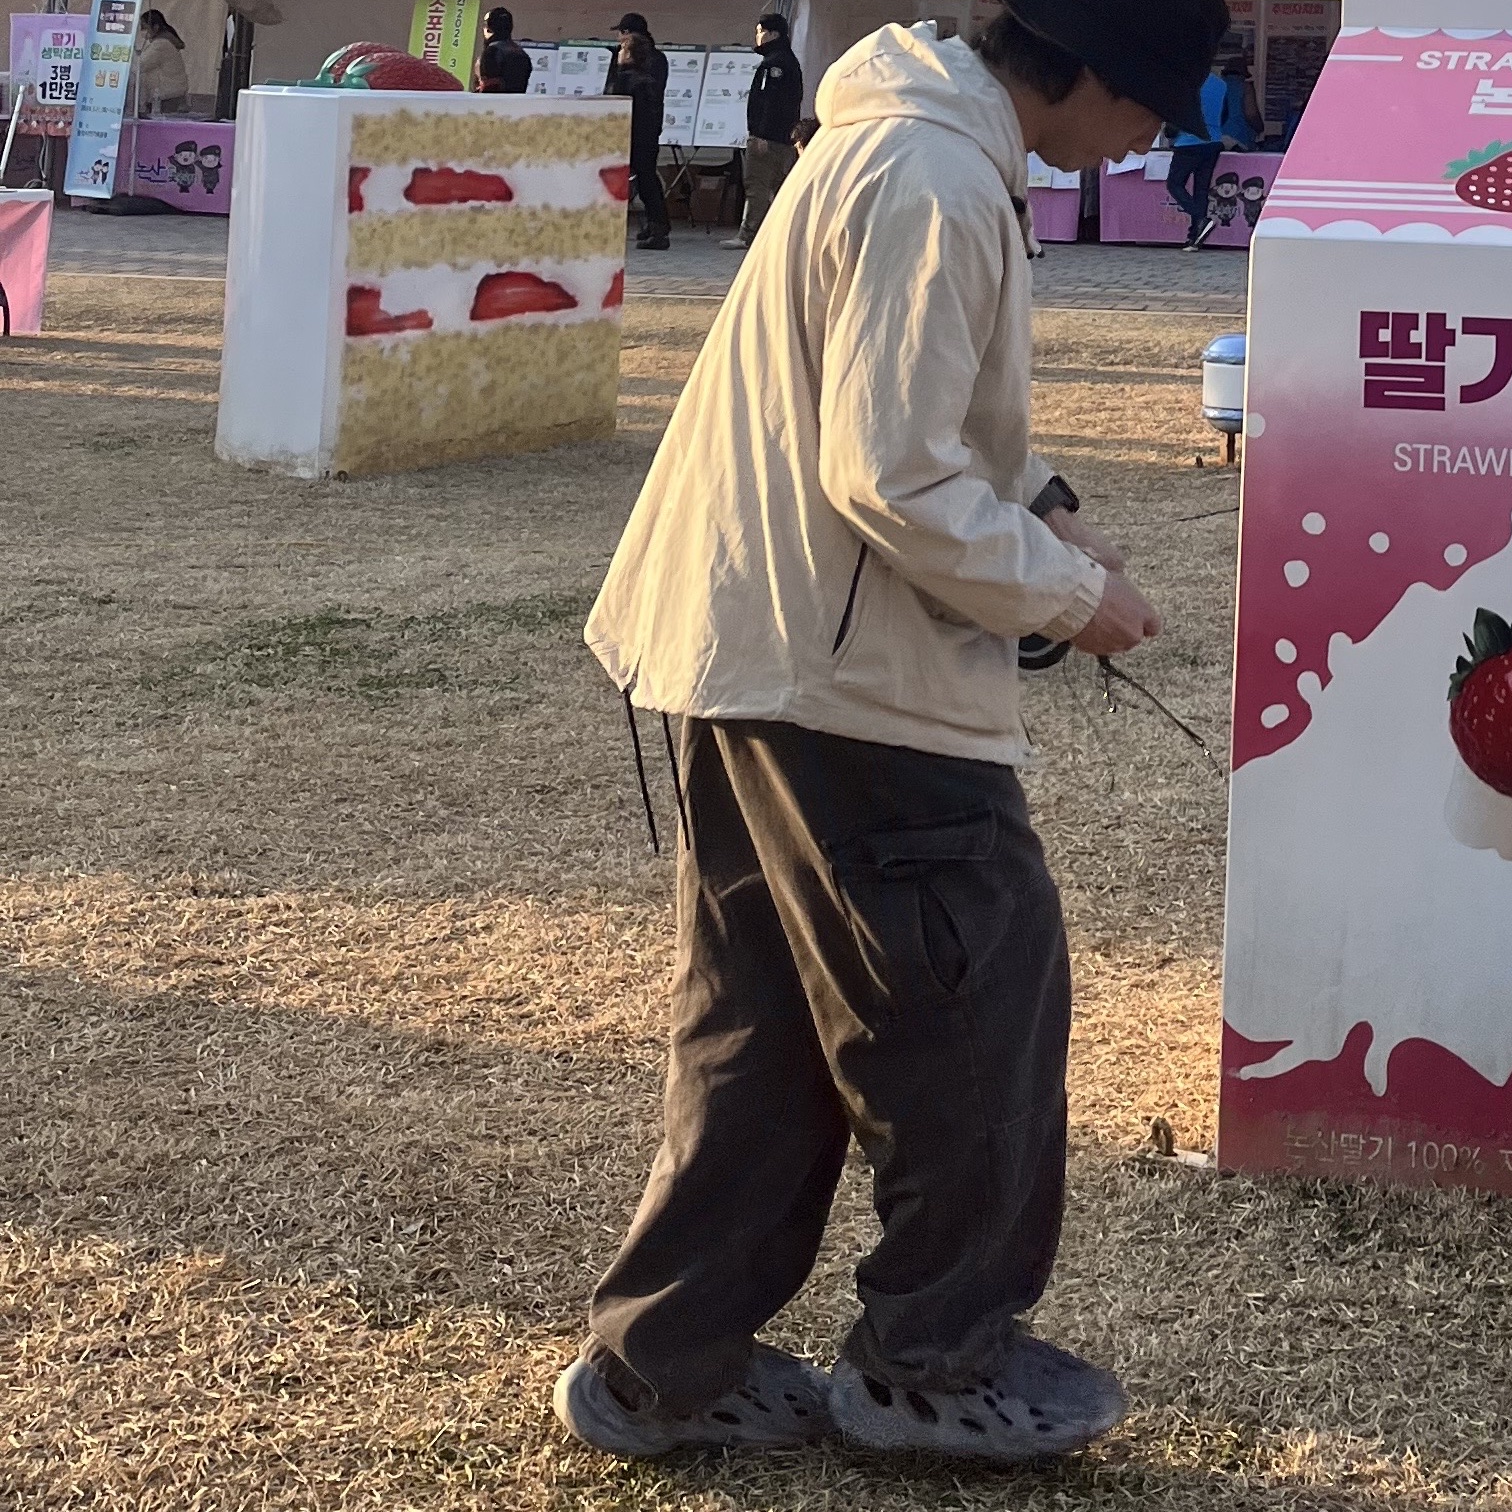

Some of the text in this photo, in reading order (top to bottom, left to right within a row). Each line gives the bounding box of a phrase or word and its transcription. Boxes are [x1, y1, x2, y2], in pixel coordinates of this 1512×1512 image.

[52, 32, 76, 47] 딸기
[38, 80, 80, 101] 1만원
[1282, 1124, 1393, 1167] 논산딸기
[1406, 1138, 1486, 1176] 100%
